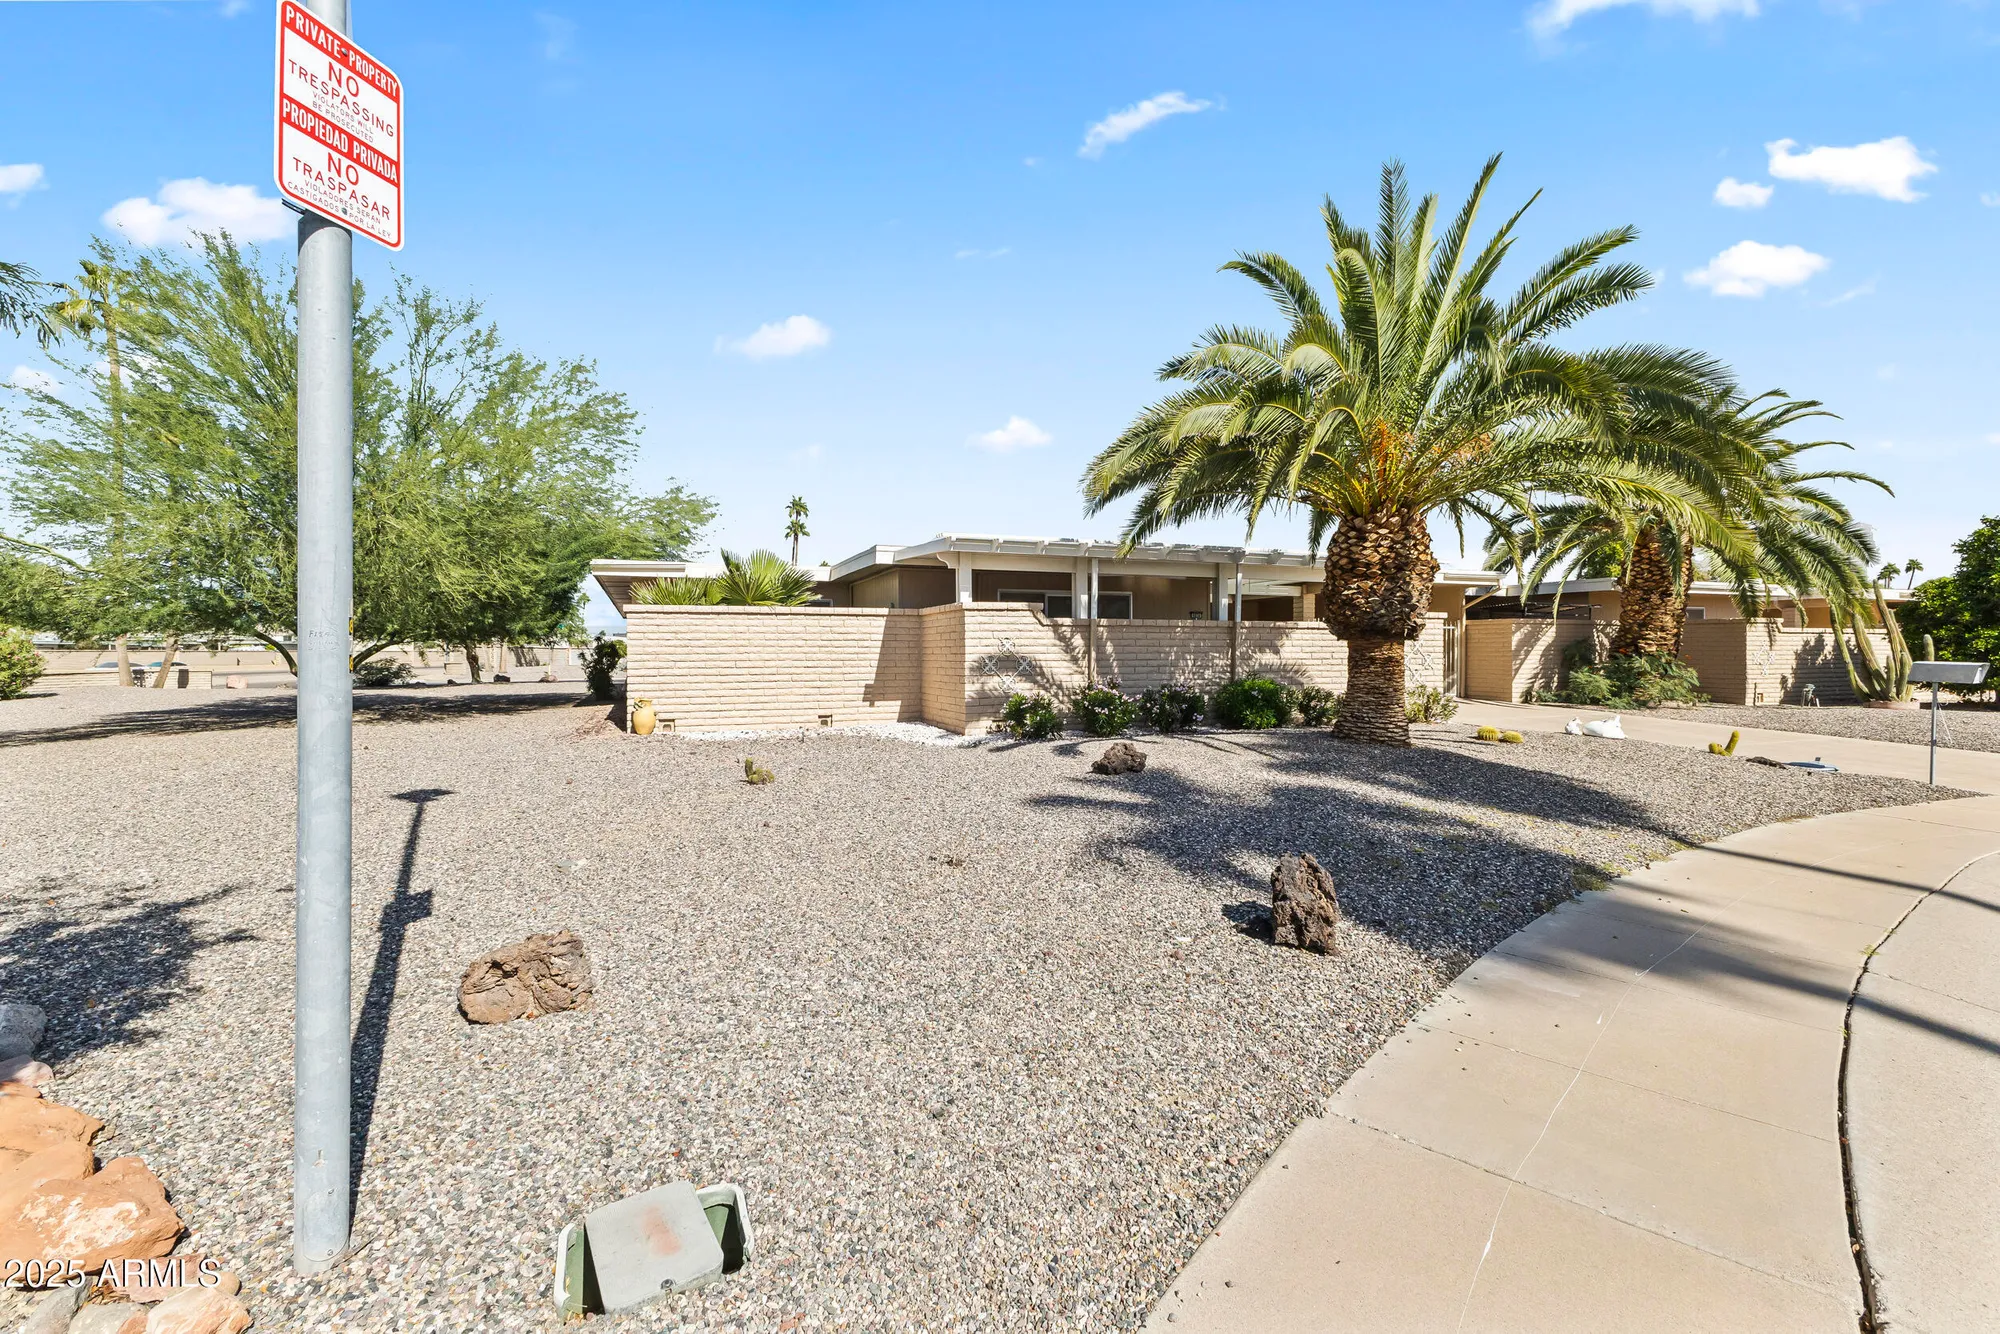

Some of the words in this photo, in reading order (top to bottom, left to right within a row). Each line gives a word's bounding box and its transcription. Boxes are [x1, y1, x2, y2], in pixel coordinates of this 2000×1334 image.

[286, 4, 341, 59] PRIVATE
[349, 49, 398, 97] PROPERTY
[288, 58, 394, 137] TRESPASSING
[328, 61, 359, 98] NO
[312, 91, 354, 122] VIOLATORS
[357, 118, 374, 135] WILL
[312, 100, 323, 113] BE
[325, 108, 374, 144] PROSECUTED
[282, 97, 349, 154] PROPIEDAD
[353, 140, 398, 183] PRIVADA
[292, 156, 390, 221] TRASPASAR
[327, 151, 360, 187] NO
[287, 181, 339, 213] CASTIGADOS
[348, 212, 364, 225] POR
[366, 221, 376, 231] LA
[377, 228, 391, 239] LEY
[304, 180, 354, 210] VIOLADORES
